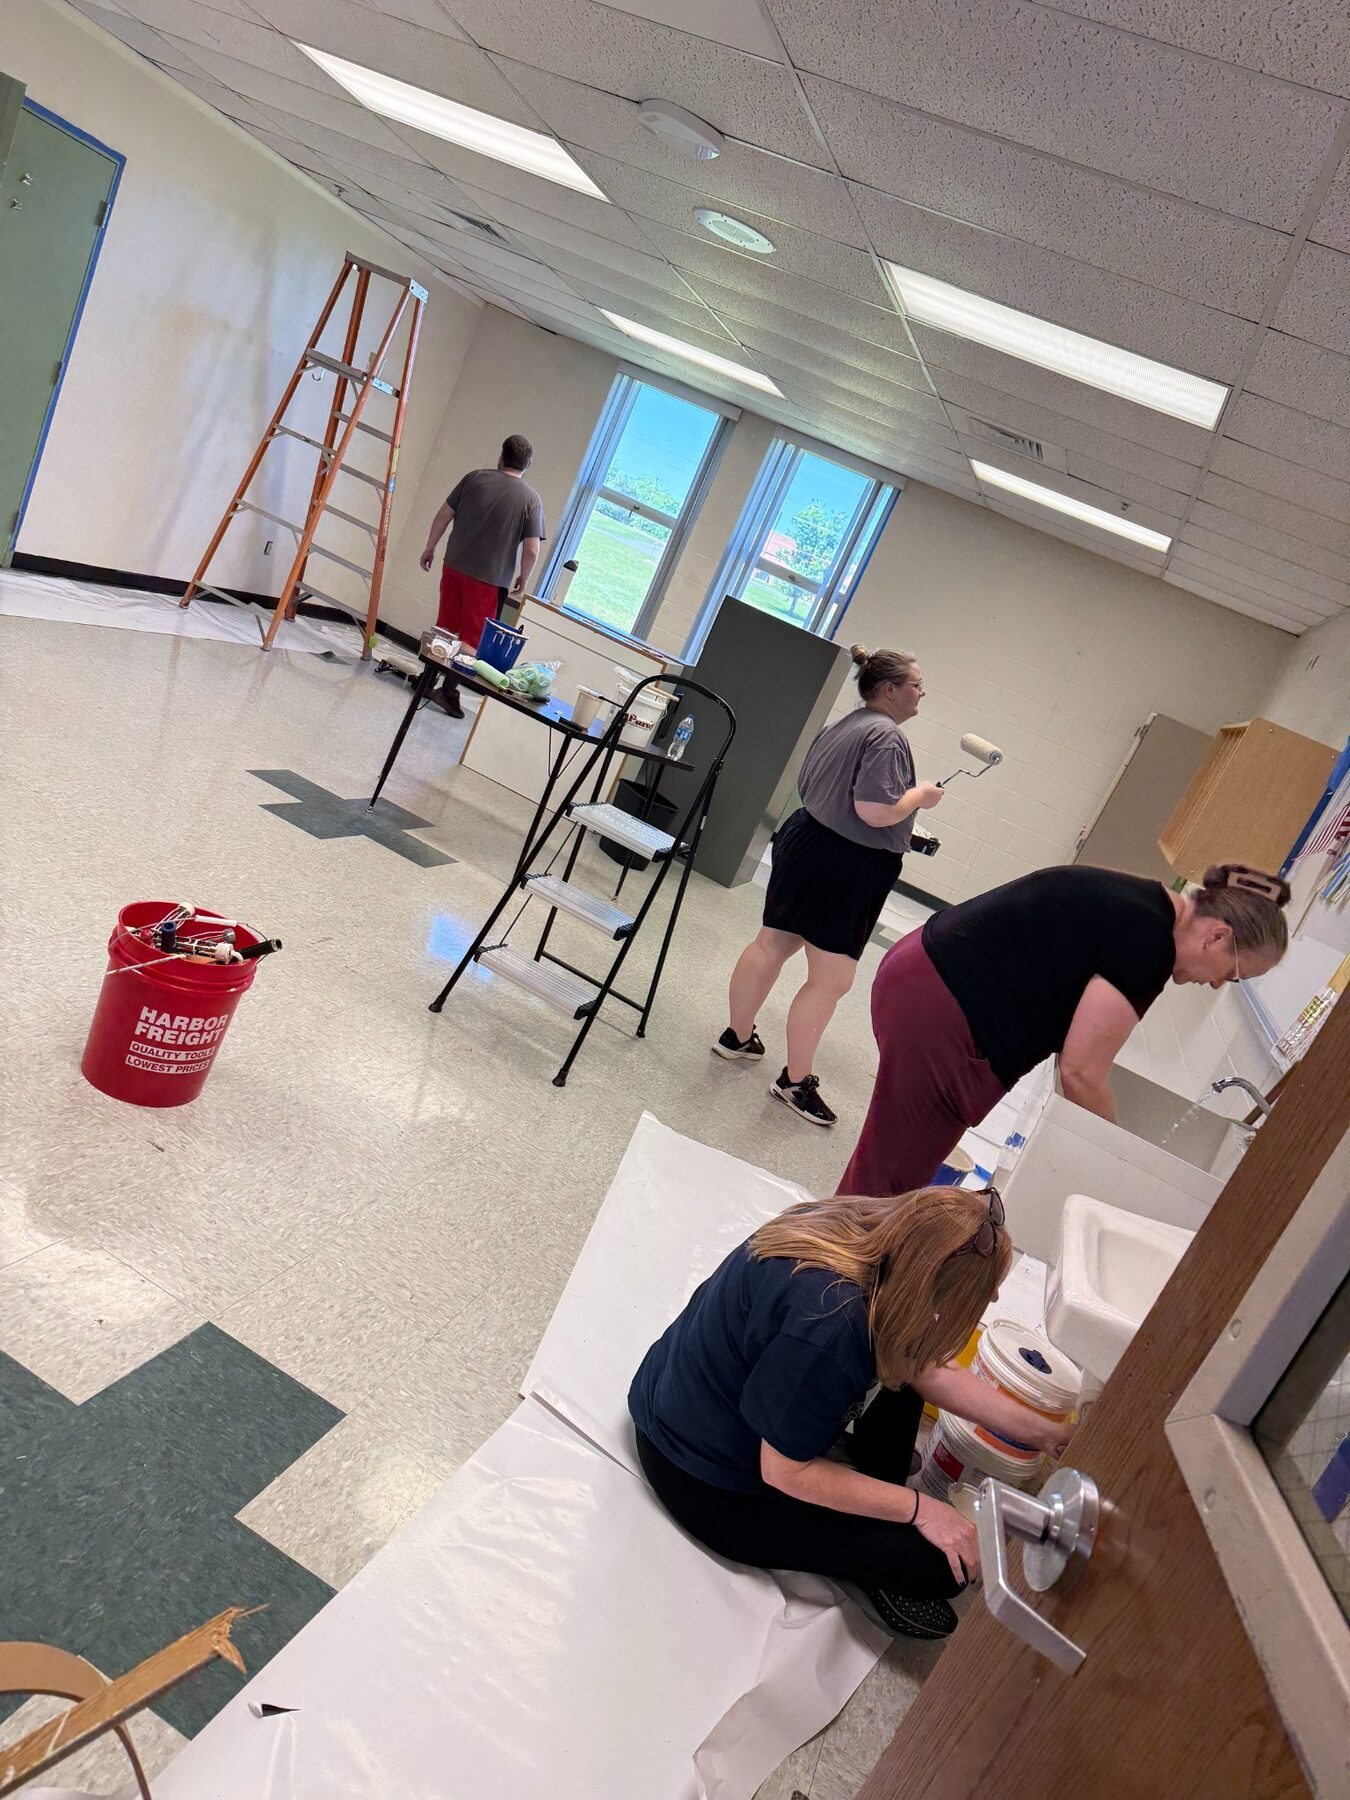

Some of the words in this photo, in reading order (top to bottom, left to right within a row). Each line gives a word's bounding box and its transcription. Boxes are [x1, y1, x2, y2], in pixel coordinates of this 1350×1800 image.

[139, 1006, 229, 1031] HARBOR
[134, 1021, 224, 1046] FREIGHT
[132, 1043, 181, 1060] QUALITY
[185, 1048, 214, 1060] TOOLS
[126, 1056, 173, 1073] LOWEST
[175, 1061, 209, 1073] PRICES
